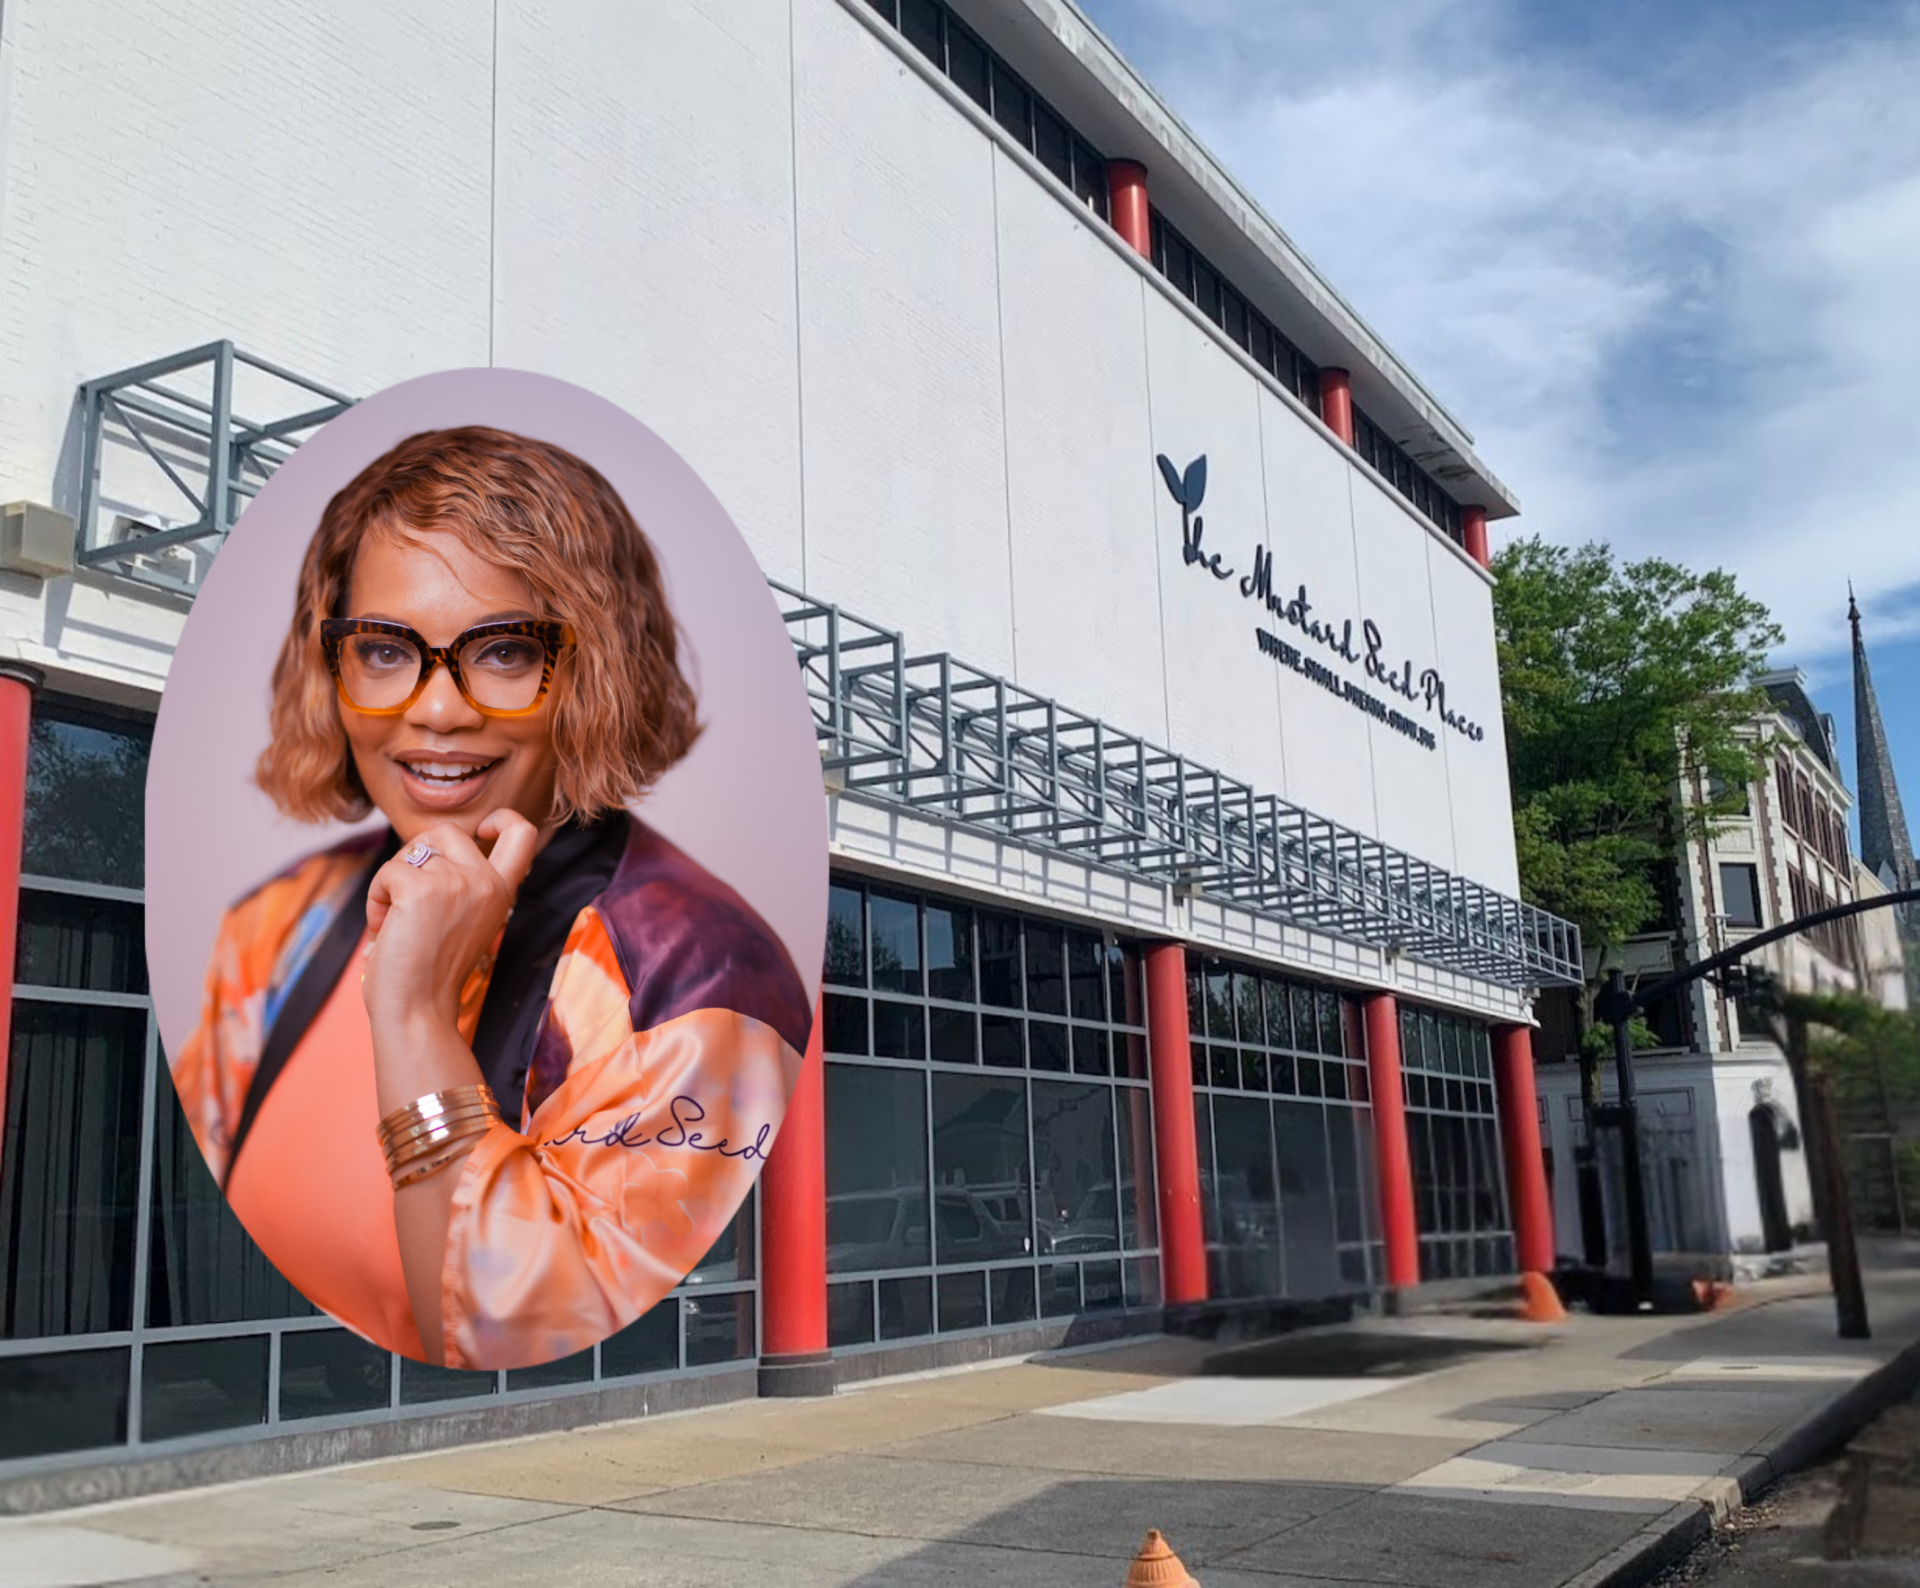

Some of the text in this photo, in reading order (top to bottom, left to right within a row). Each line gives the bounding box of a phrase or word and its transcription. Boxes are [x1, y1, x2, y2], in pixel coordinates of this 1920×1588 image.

[1240, 543, 1360, 664] Mustard
[1363, 619, 1420, 702] Seed
[657, 1095, 771, 1160] Seed
